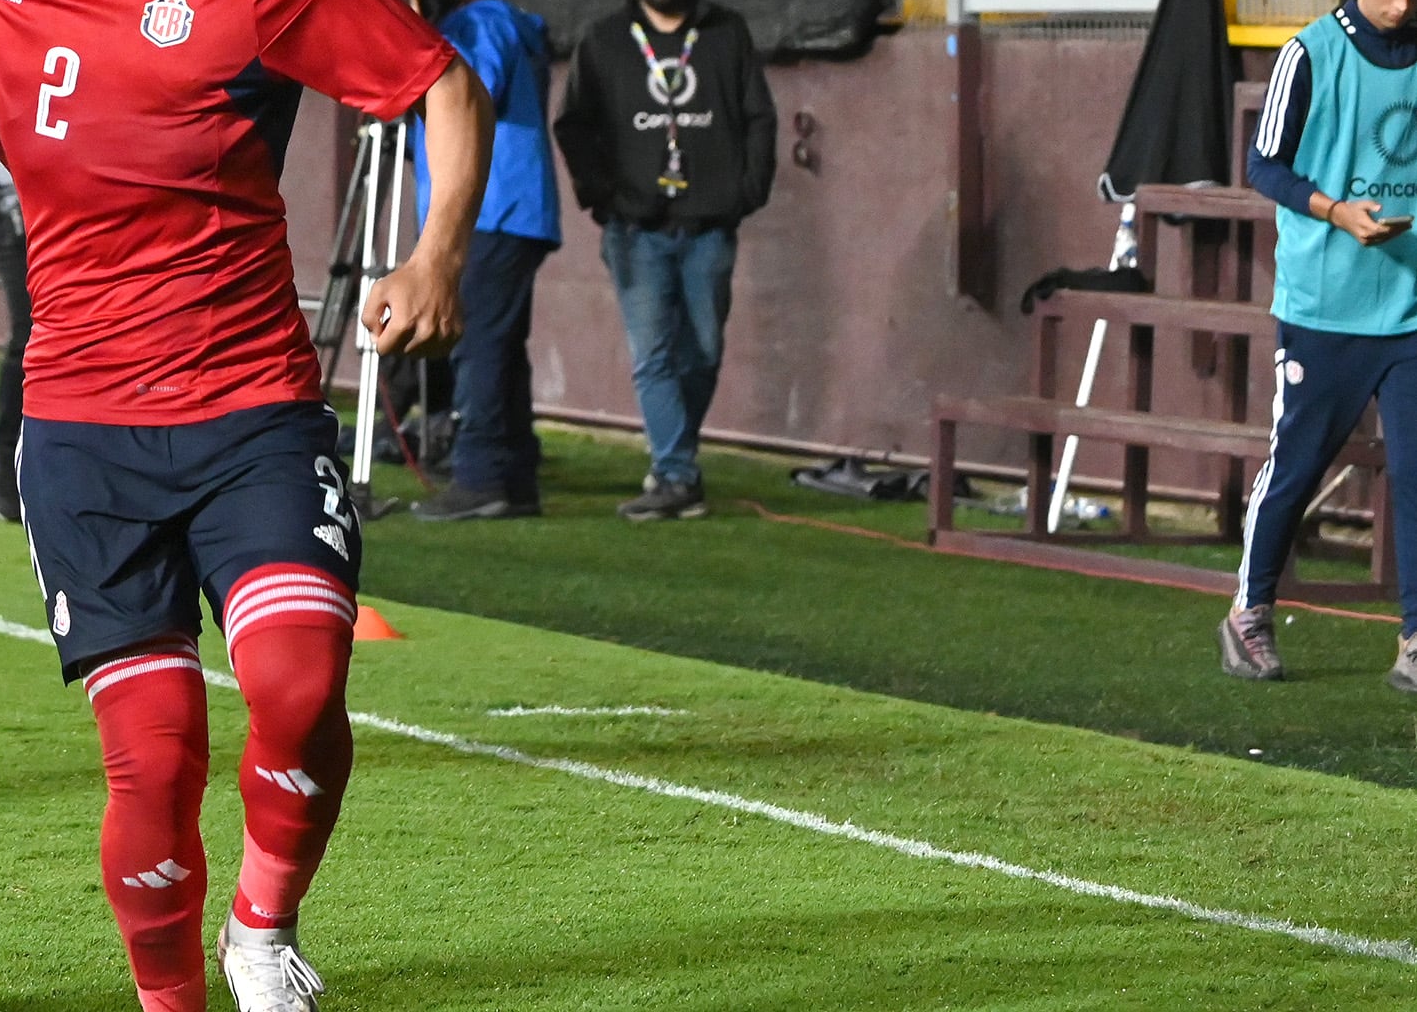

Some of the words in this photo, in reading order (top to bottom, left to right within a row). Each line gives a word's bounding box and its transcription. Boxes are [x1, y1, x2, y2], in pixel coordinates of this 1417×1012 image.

[152, 6, 183, 37] CR
[34, 46, 81, 141] 2
[1349, 176, 1417, 199] Conca
[314, 455, 353, 533] 2
